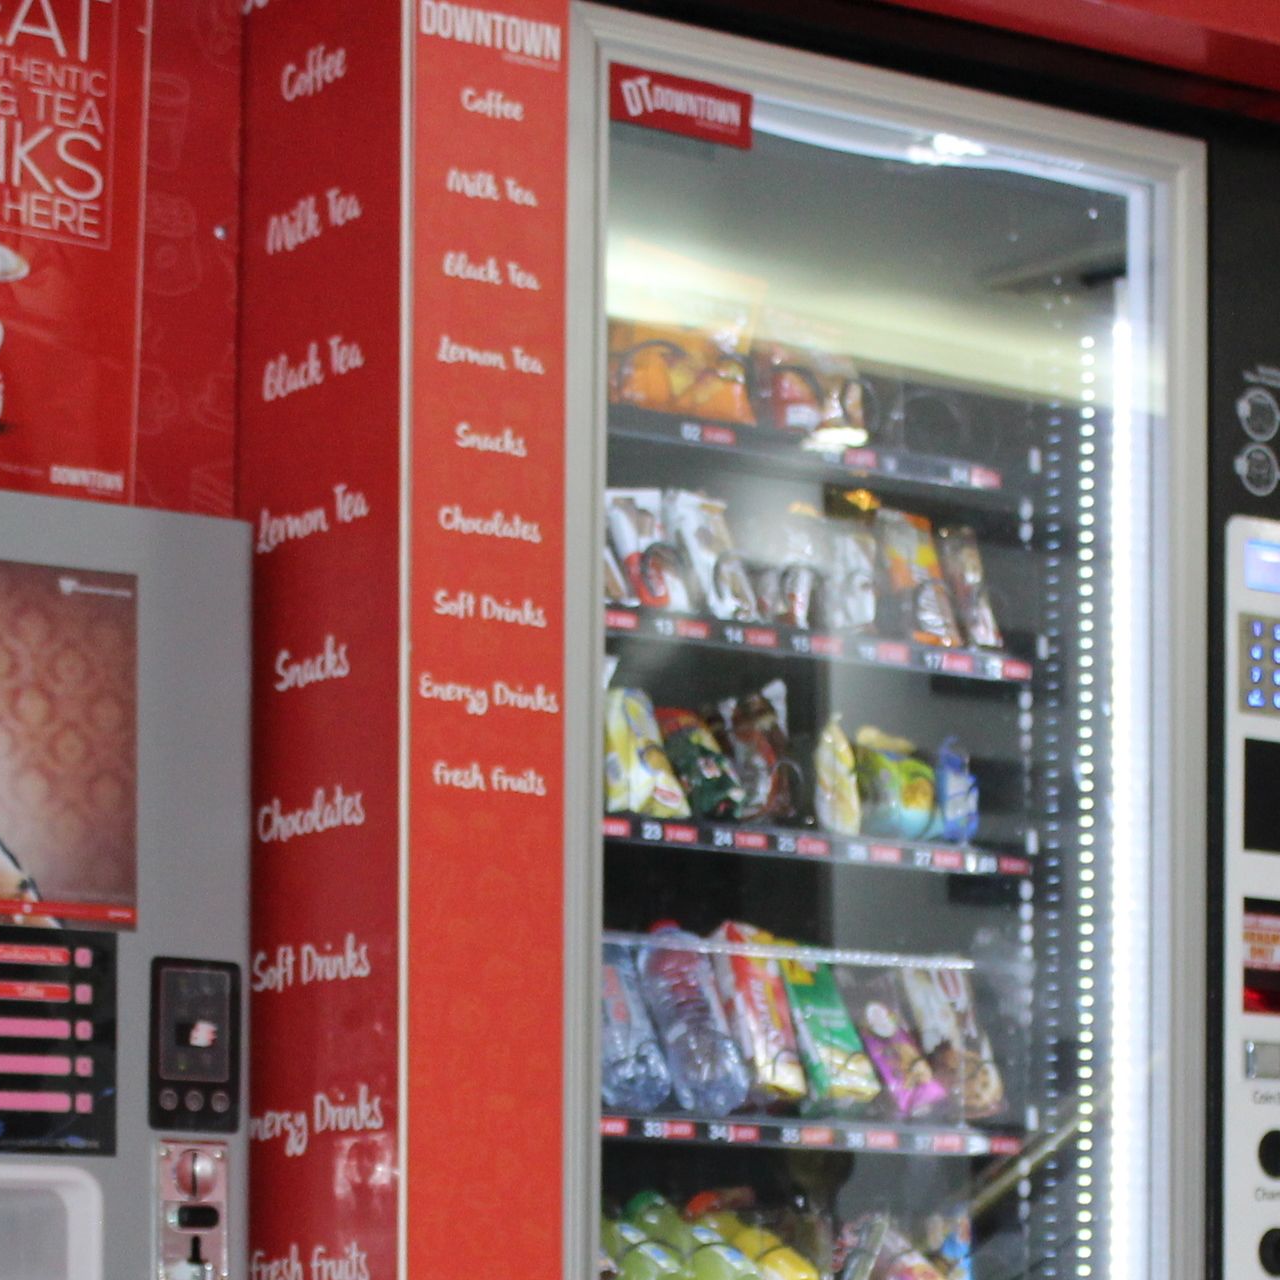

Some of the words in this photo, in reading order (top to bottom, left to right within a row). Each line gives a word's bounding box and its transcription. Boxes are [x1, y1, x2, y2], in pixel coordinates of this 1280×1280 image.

[420, 0, 561, 62] DOWNTOWN
[281, 44, 347, 102] Coffee
[30, 87, 104, 134] TEA
[460, 87, 524, 121] Coffee
[446, 167, 501, 201] Milk
[505, 176, 538, 208] Tea
[2, 194, 100, 239] HERE
[265, 195, 321, 255] Milk
[326, 185, 363, 227] Tea
[443, 252, 502, 286] Black
[507, 259, 541, 292] Tea
[262, 341, 324, 402] Black
[328, 333, 365, 376] Tea
[437, 334, 507, 371] Lemon
[512, 344, 545, 376] Tea
[454, 420, 527, 458] Snacks
[256, 506, 329, 554] Lemon
[333, 482, 370, 523] Tea
[437, 505, 543, 544] Chocolates
[433, 589, 477, 619] Soft
[480, 594, 547, 629] Drinks
[274, 633, 351, 692] Snacks
[419, 672, 490, 716] Energy
[493, 680, 560, 715] Drinks
[257, 783, 366, 843] Chocolates
[642, 822, 662, 840] 23
[714, 829, 733, 846] 24
[251, 943, 296, 994] Soft
[301, 932, 372, 983] Drinks
[248, 1108, 309, 1158] nergy
[313, 1084, 385, 1135] Drinks
[644, 1122, 662, 1138] 33
[709, 1124, 727, 1140] 34
